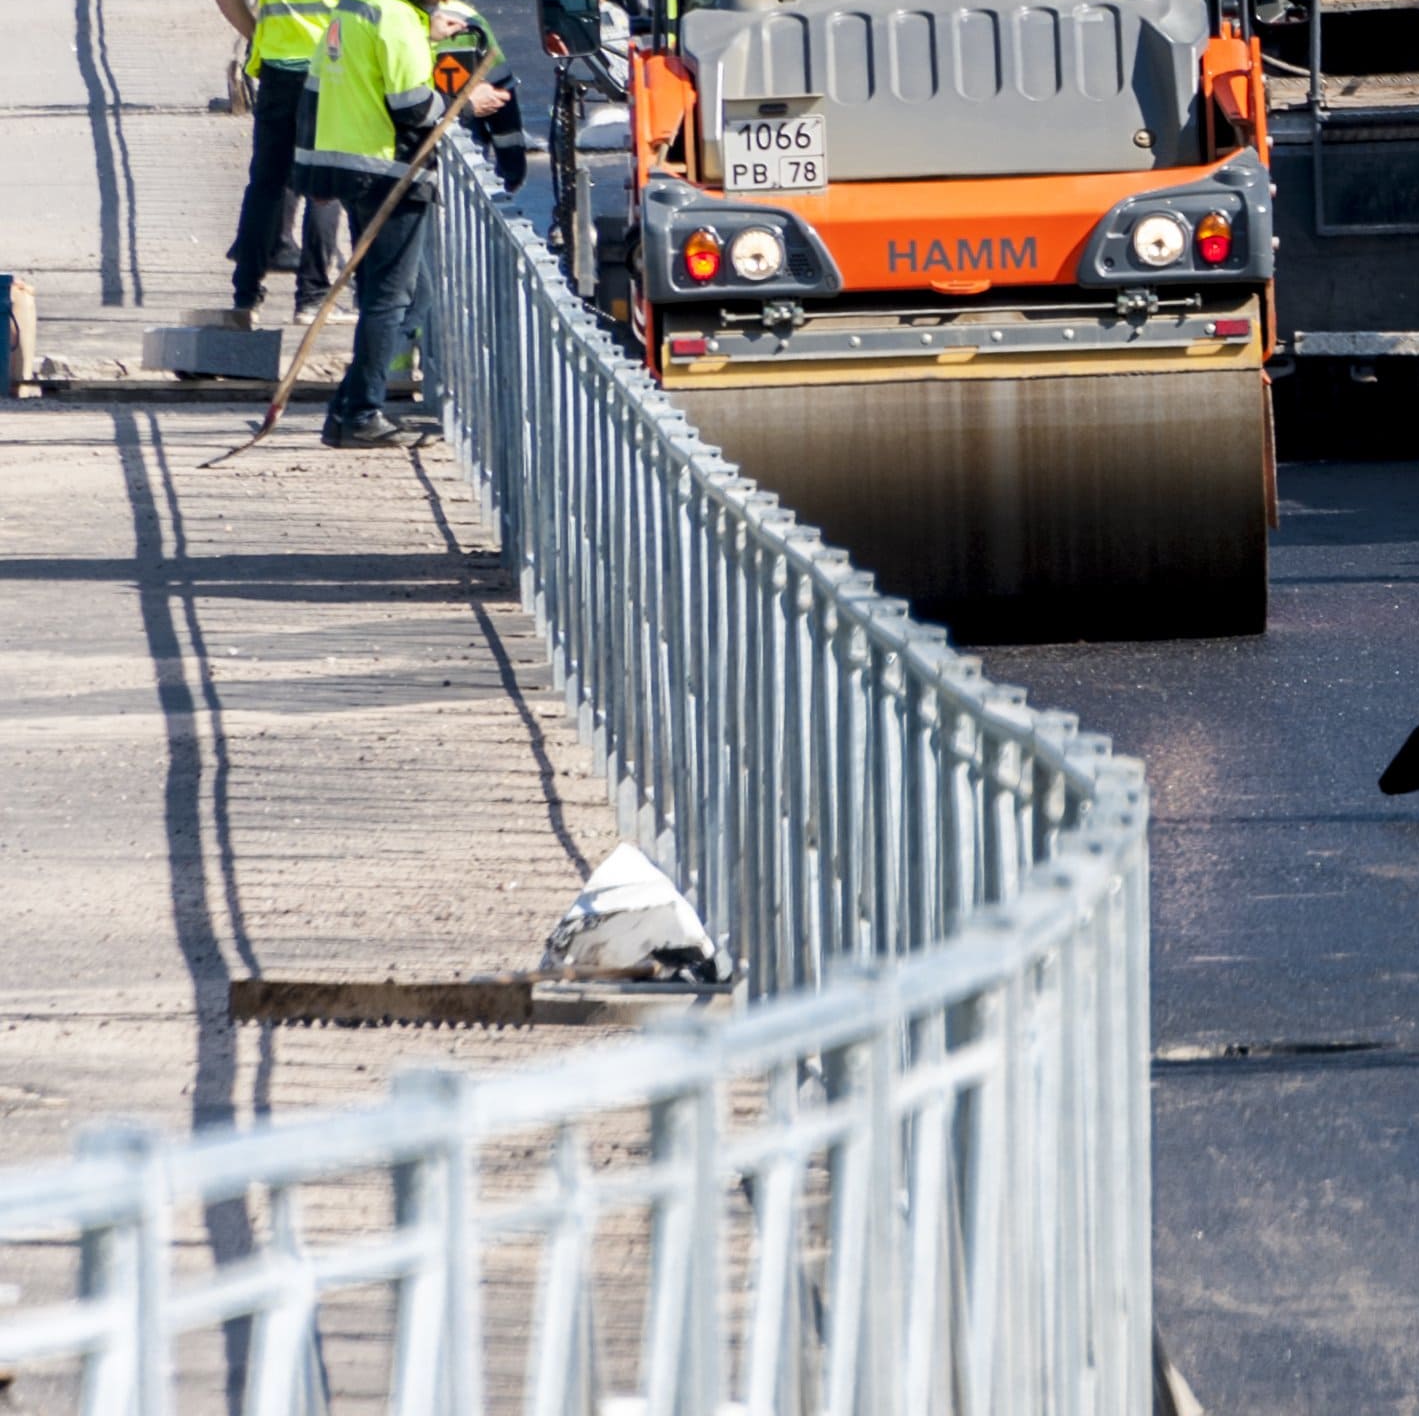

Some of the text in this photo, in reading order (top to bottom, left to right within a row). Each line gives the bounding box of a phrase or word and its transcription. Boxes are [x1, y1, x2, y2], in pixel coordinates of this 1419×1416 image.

[738, 122, 812, 152] 1066
[788, 161, 817, 183] 78
[887, 236, 1038, 273] HAMM
